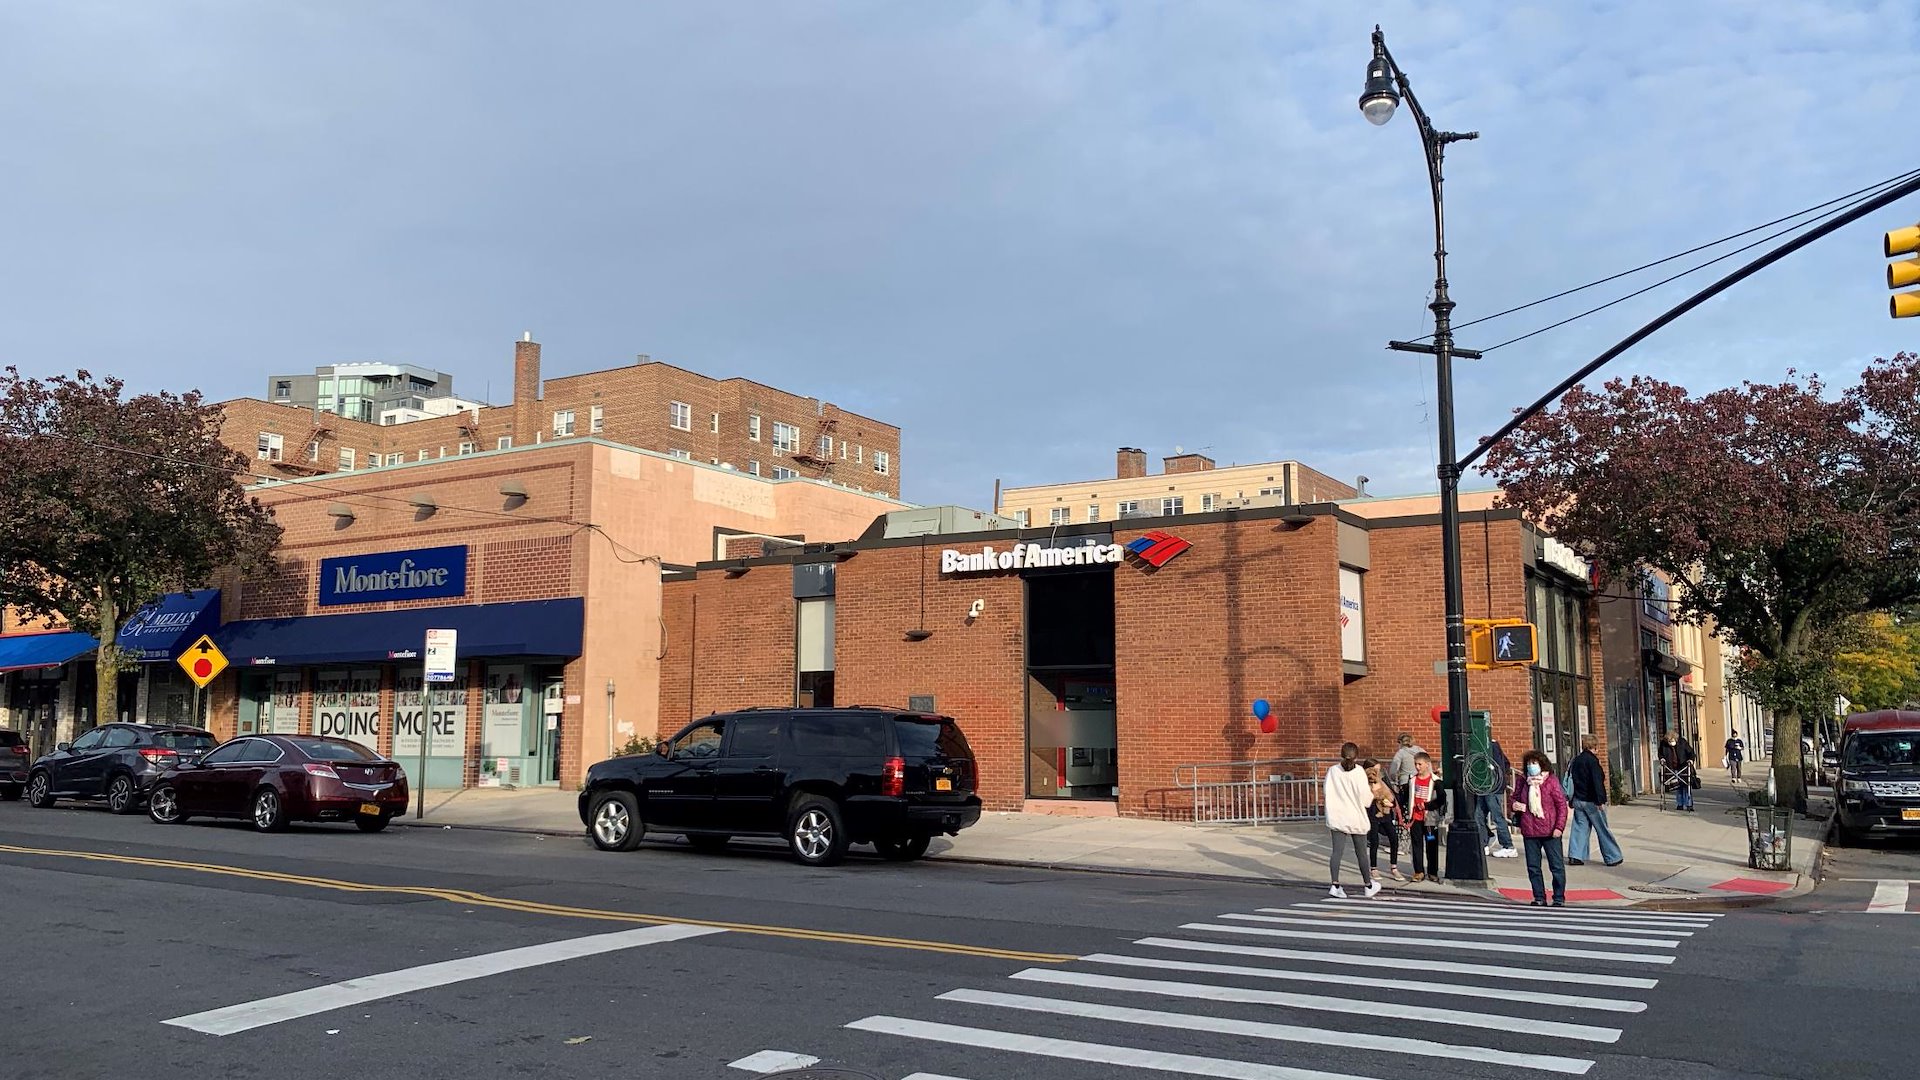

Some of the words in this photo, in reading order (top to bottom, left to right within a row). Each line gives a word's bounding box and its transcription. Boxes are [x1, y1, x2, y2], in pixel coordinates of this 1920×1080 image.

[942, 546, 1000, 573] Bank
[999, 543, 1027, 569] of
[1024, 543, 1124, 568] America
[333, 558, 449, 594] Montefiore
[388, 649, 417, 659] Montefiore
[320, 711, 380, 735] DOING
